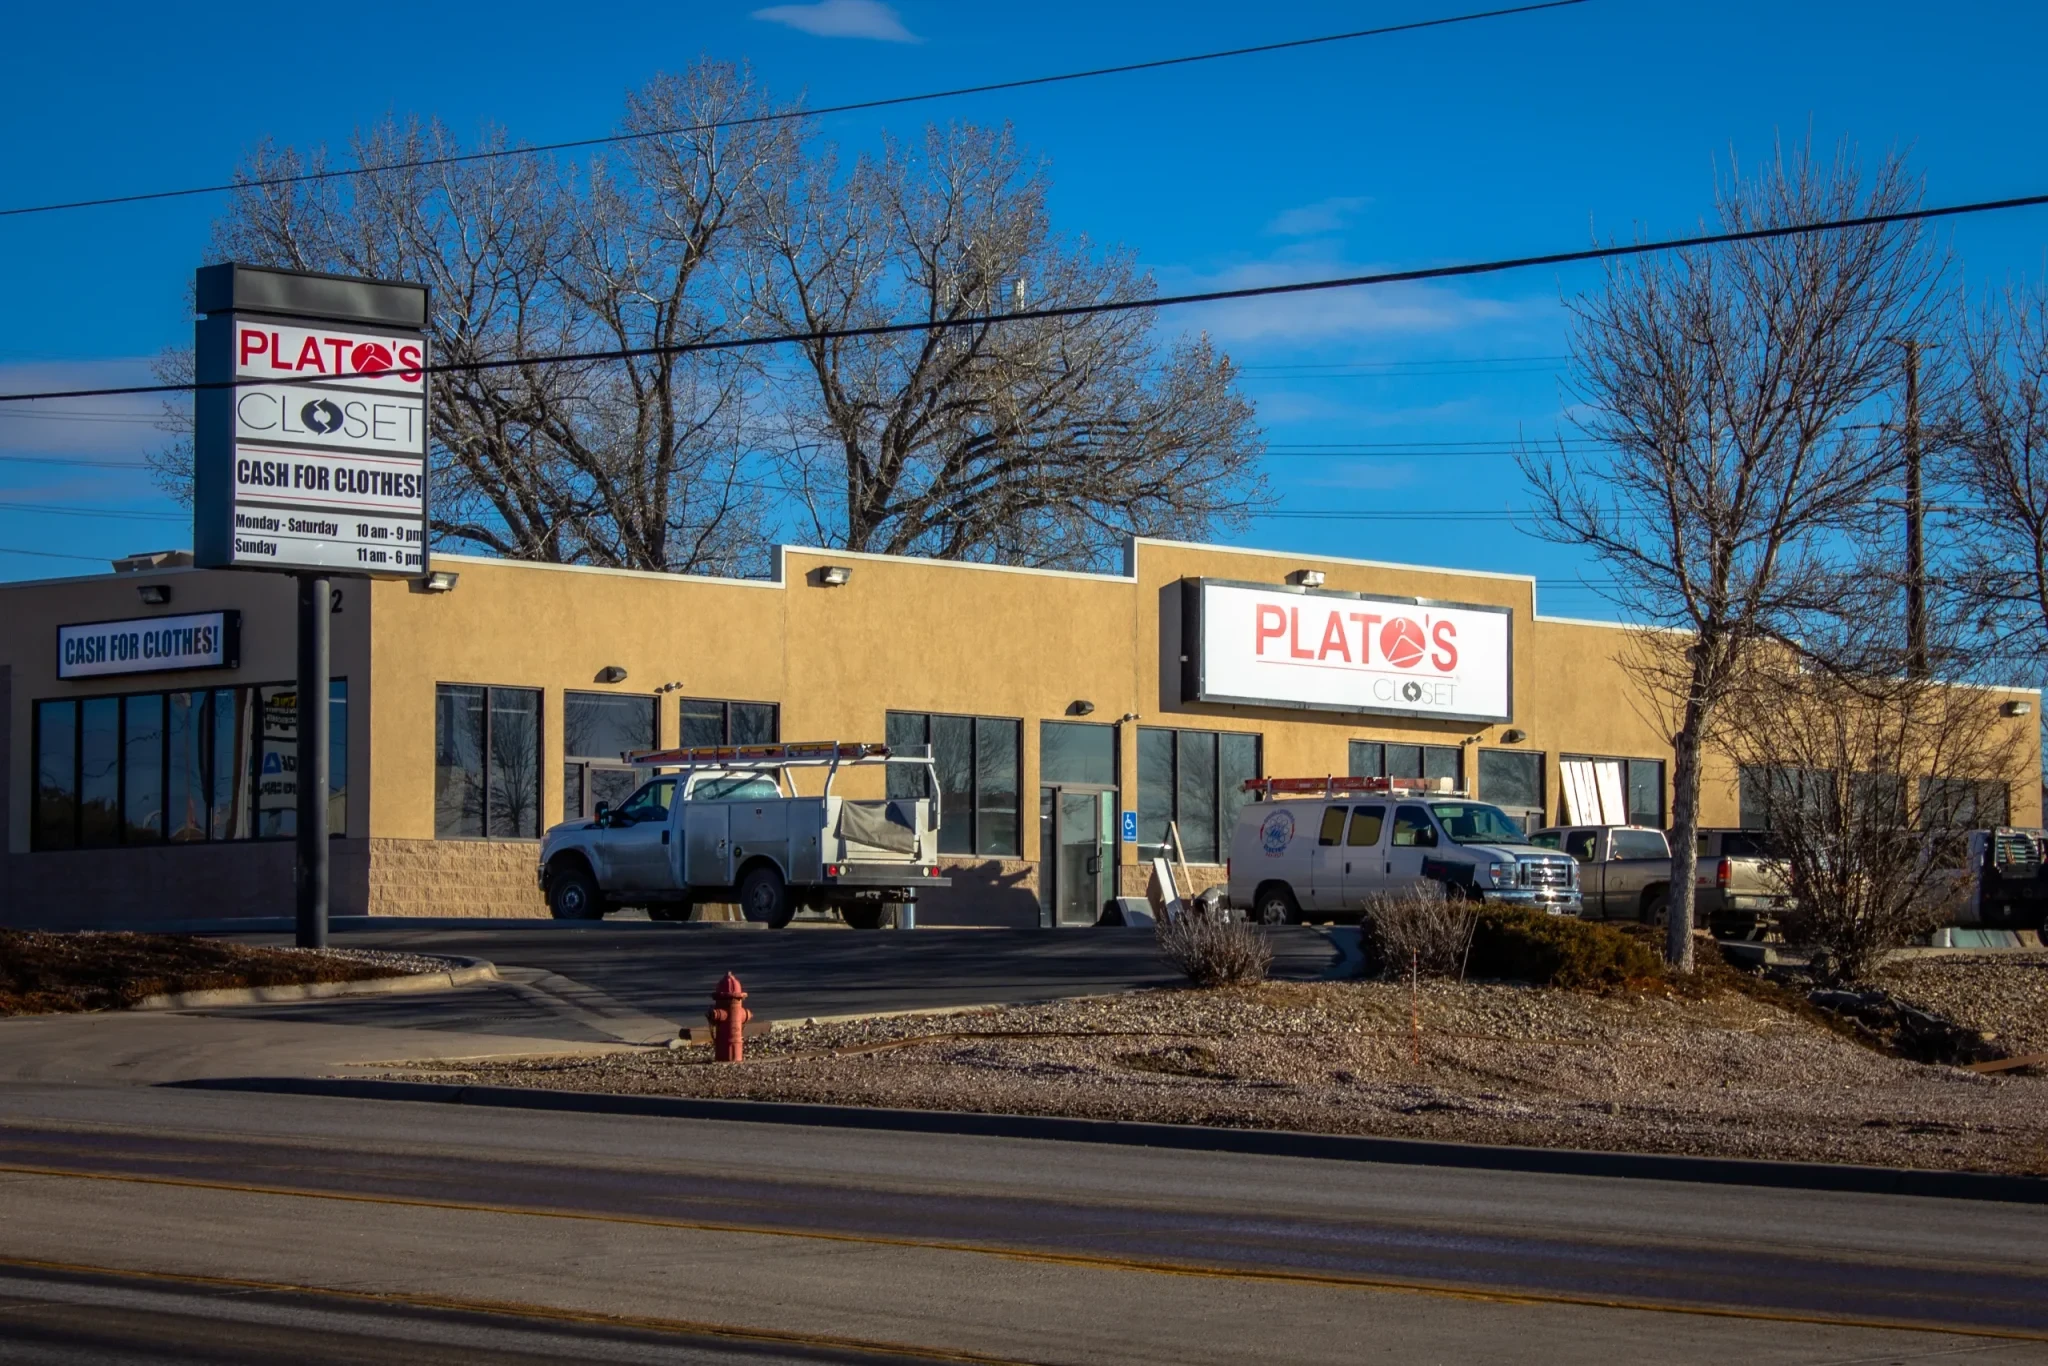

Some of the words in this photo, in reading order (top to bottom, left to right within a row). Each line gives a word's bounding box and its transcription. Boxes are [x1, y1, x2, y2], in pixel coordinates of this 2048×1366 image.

[240, 329, 422, 383] PLATO'S
[237, 392, 423, 443] CLOSET
[237, 459, 289, 488] CASH
[294, 464, 329, 491] FOR
[334, 467, 422, 499] CLOTHES!
[235, 513, 280, 532] Monday
[288, 517, 338, 537] Saturday
[356, 523, 369, 538] 10
[370, 526, 388, 539] am
[396, 526, 404, 541] 9
[405, 529, 422, 542] pm
[235, 538, 277, 556] Sunday
[356, 547, 367, 562] 11
[369, 550, 386, 563] am
[395, 550, 403, 565] 6
[405, 553, 422, 566] pm
[65, 635, 106, 665] CASH
[110, 632, 139, 662] FOR
[143, 625, 219, 659] CLOTHES!
[1256, 603, 1459, 673] PLATO'S
[1373, 678, 1458, 706] CLOSET
